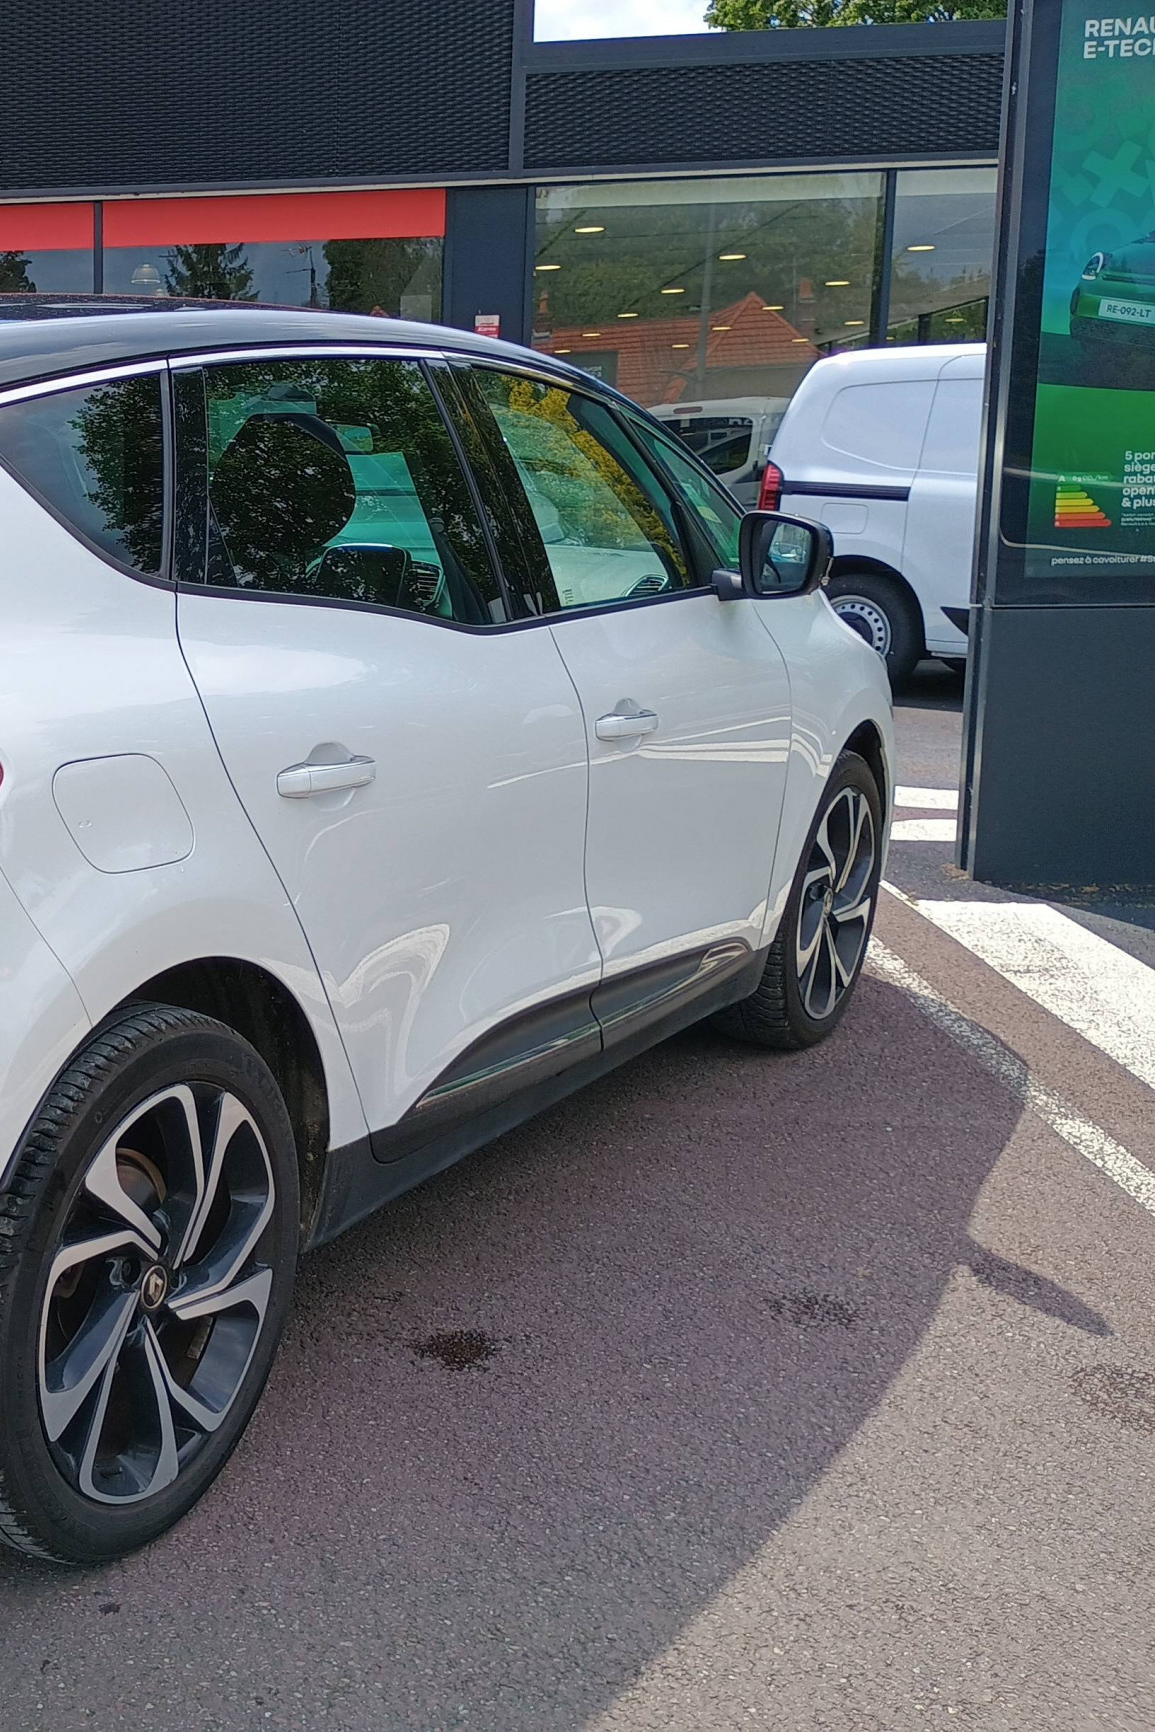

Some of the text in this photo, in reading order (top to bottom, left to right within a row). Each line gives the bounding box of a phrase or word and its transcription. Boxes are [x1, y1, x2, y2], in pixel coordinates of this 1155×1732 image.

[1083, 38, 1155, 59] E-TEC
[1106, 303, 1152, 318] RE-092-LT
[1125, 451, 1133, 460] 5
[1122, 486, 1155, 497] open
[1121, 497, 1132, 508] &
[1051, 557, 1084, 566] pensez
[1085, 555, 1092, 564] à
